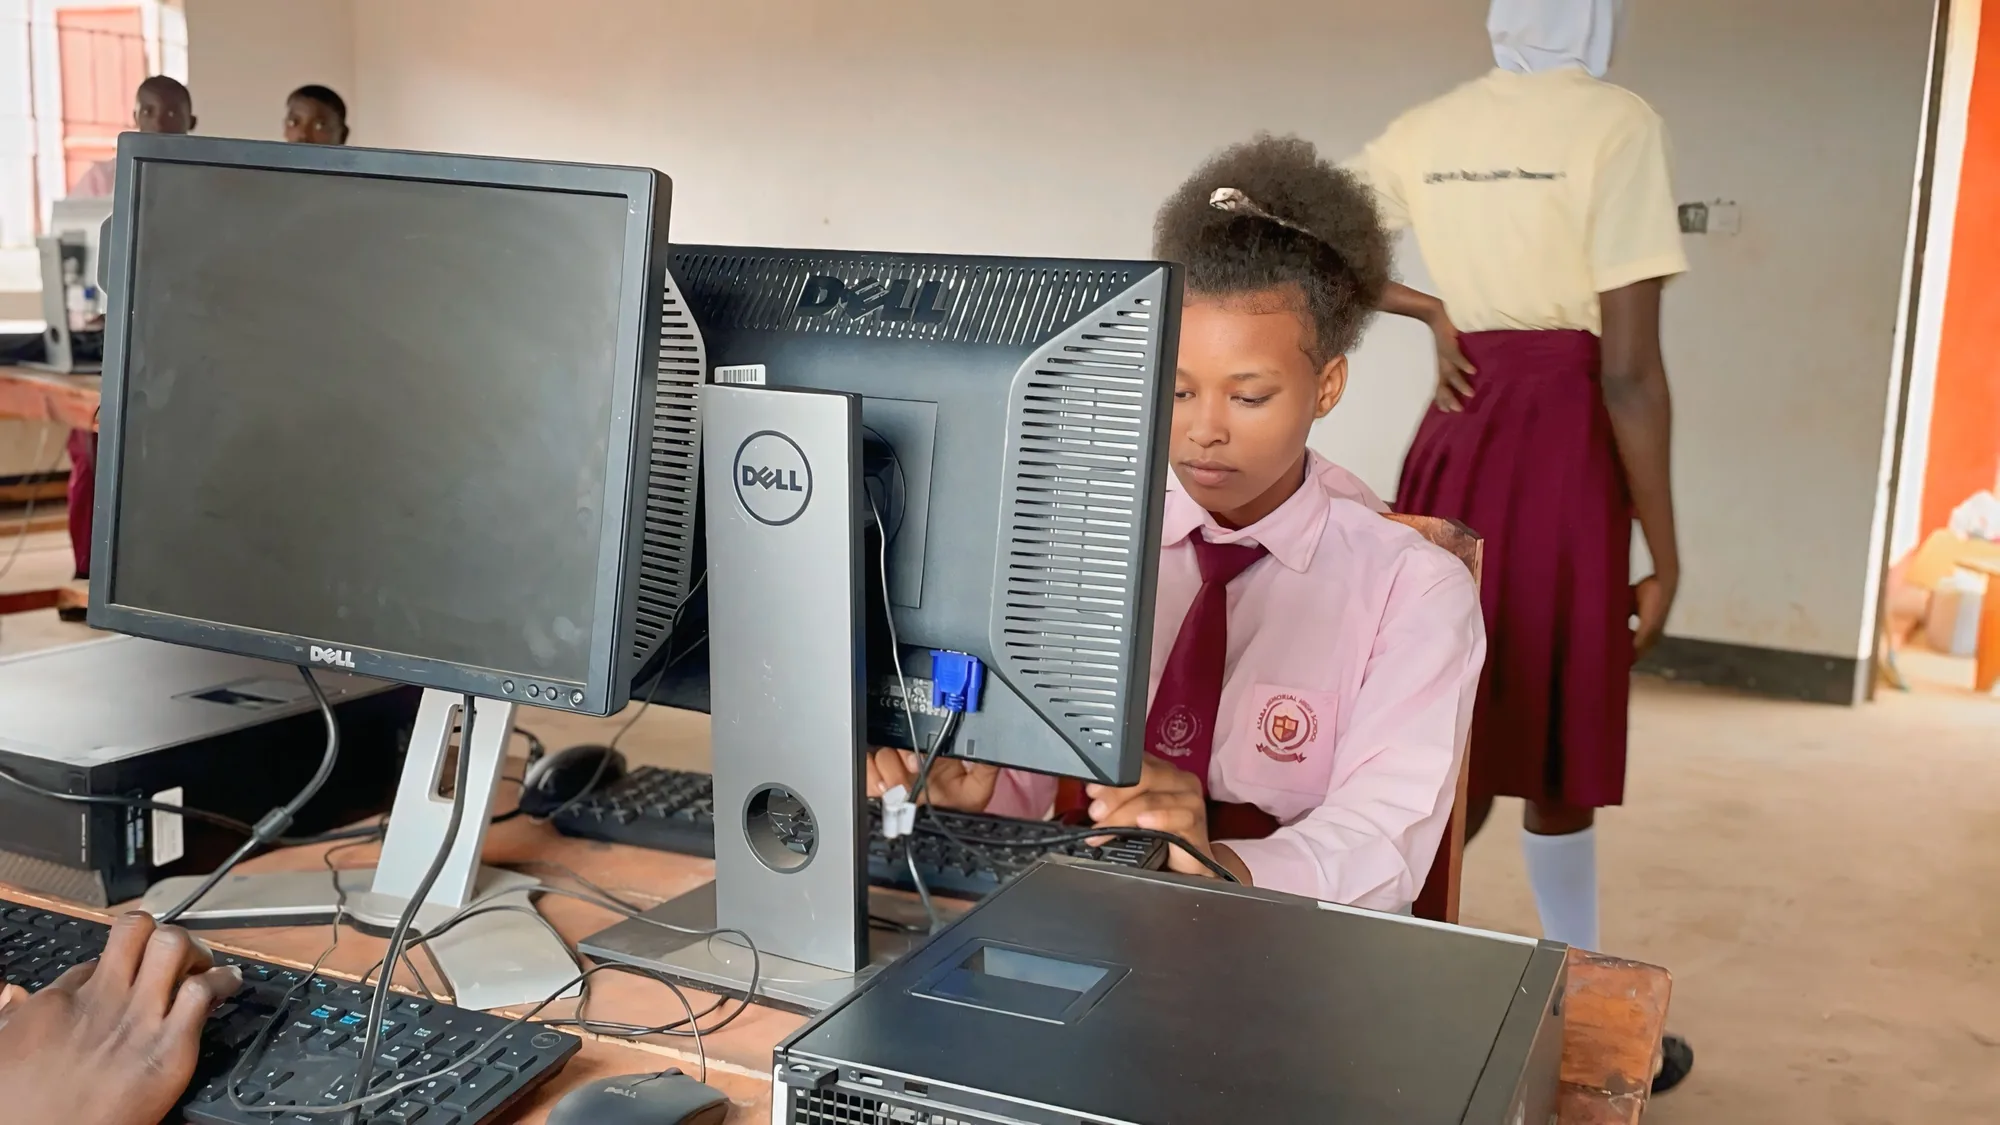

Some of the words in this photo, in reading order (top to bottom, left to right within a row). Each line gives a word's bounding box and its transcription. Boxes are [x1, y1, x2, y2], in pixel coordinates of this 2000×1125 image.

[796, 275, 947, 324] DELL
[742, 465, 803, 491] DELL
[310, 645, 355, 668] DELL
